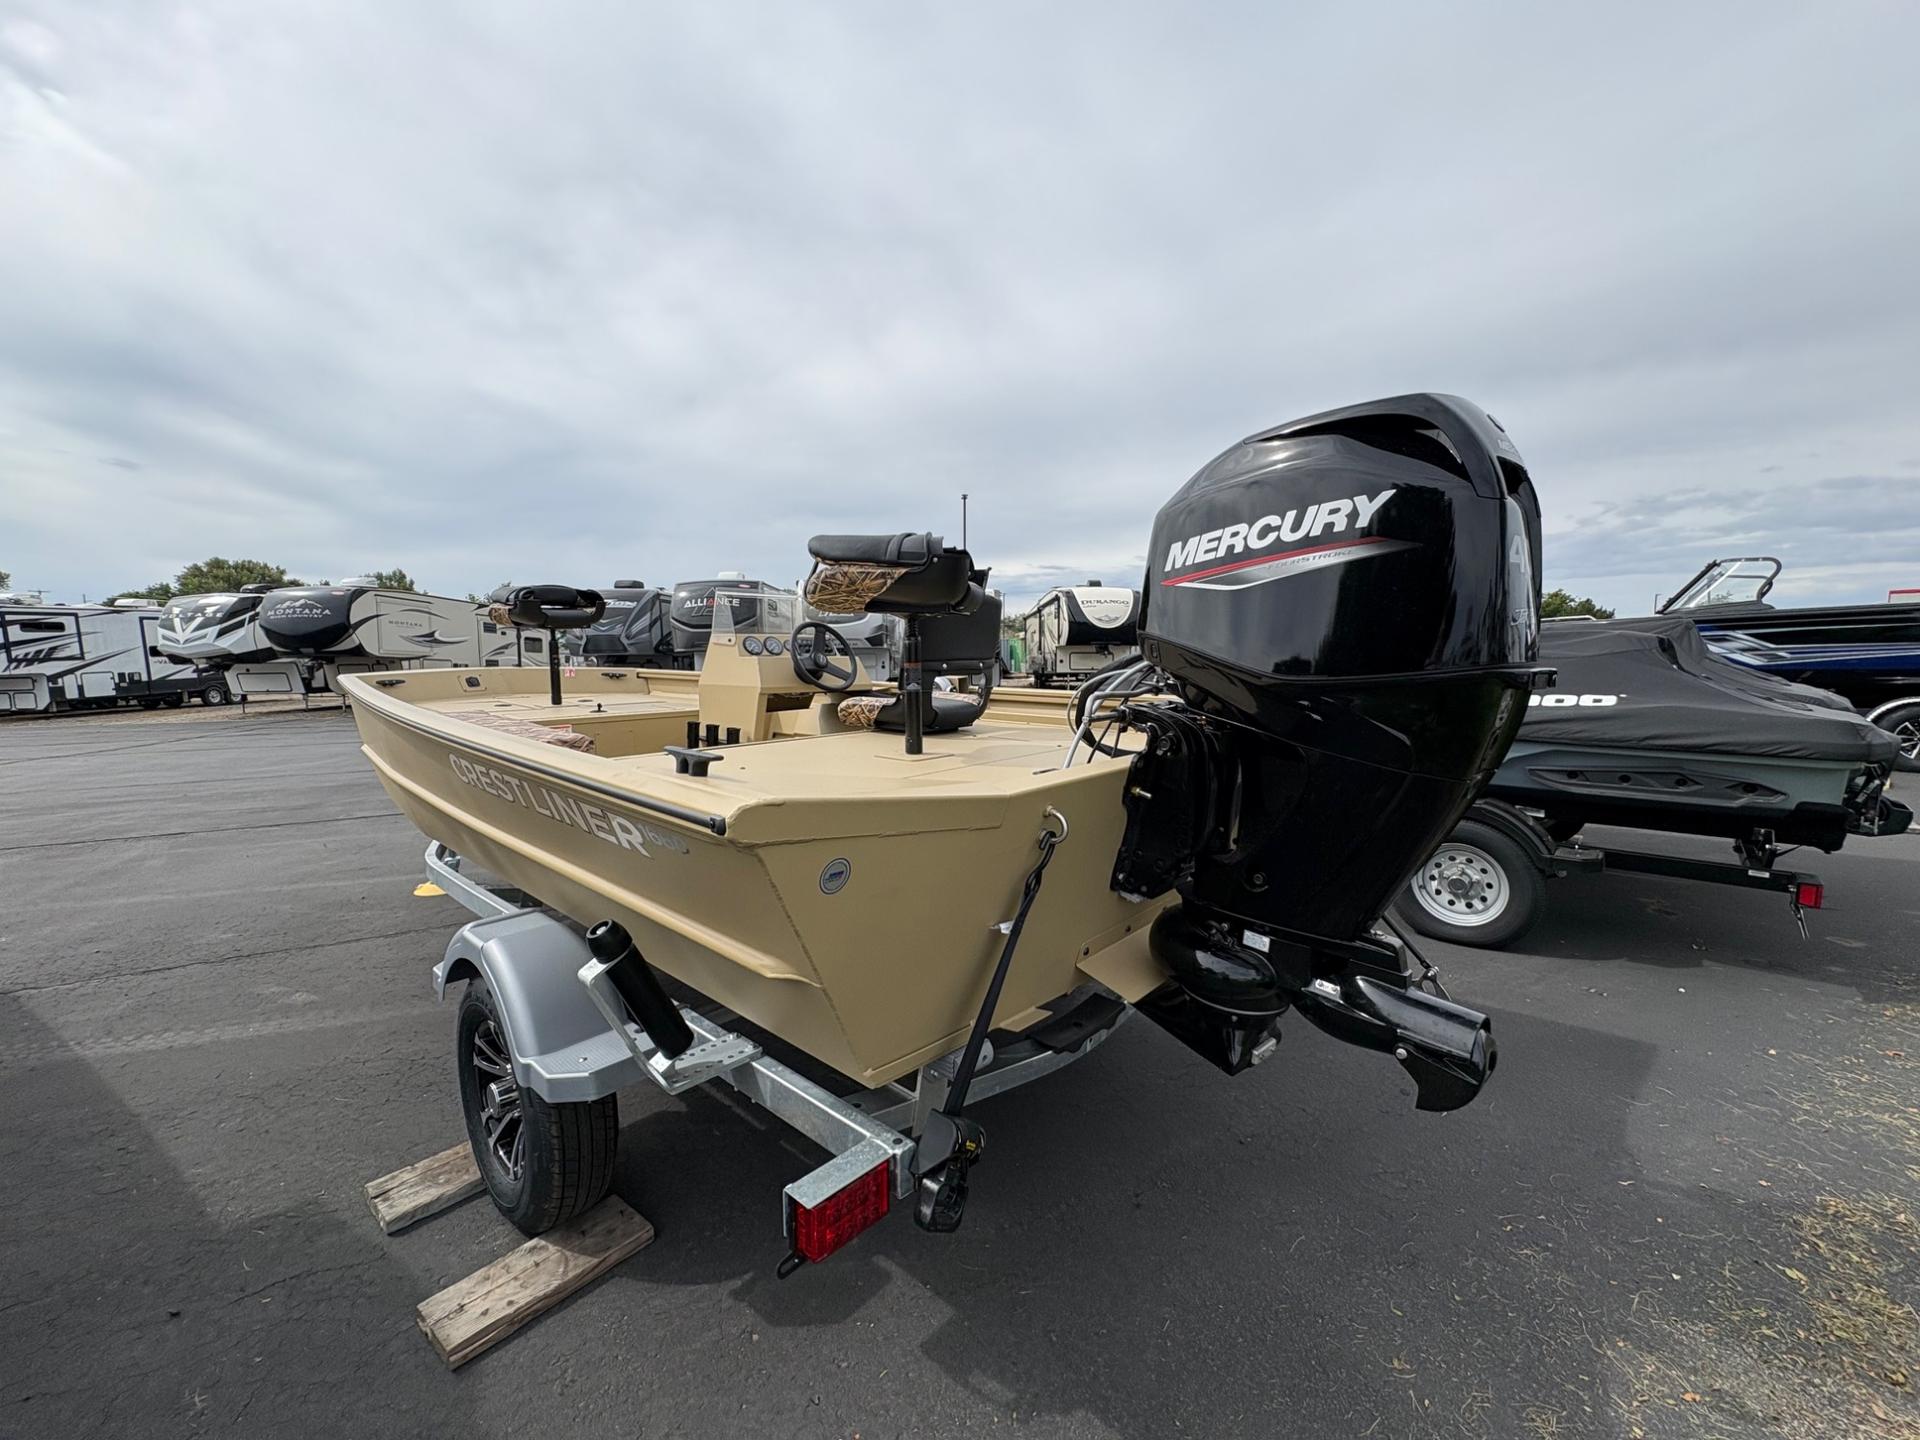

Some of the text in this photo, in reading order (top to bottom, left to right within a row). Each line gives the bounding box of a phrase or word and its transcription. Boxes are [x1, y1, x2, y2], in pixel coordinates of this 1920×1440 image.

[1164, 489, 1397, 572] MERCURY
[266, 608, 332, 616] MONTANA
[684, 597, 740, 608] ALLIANCE
[448, 753, 651, 858] CRESTLINER
